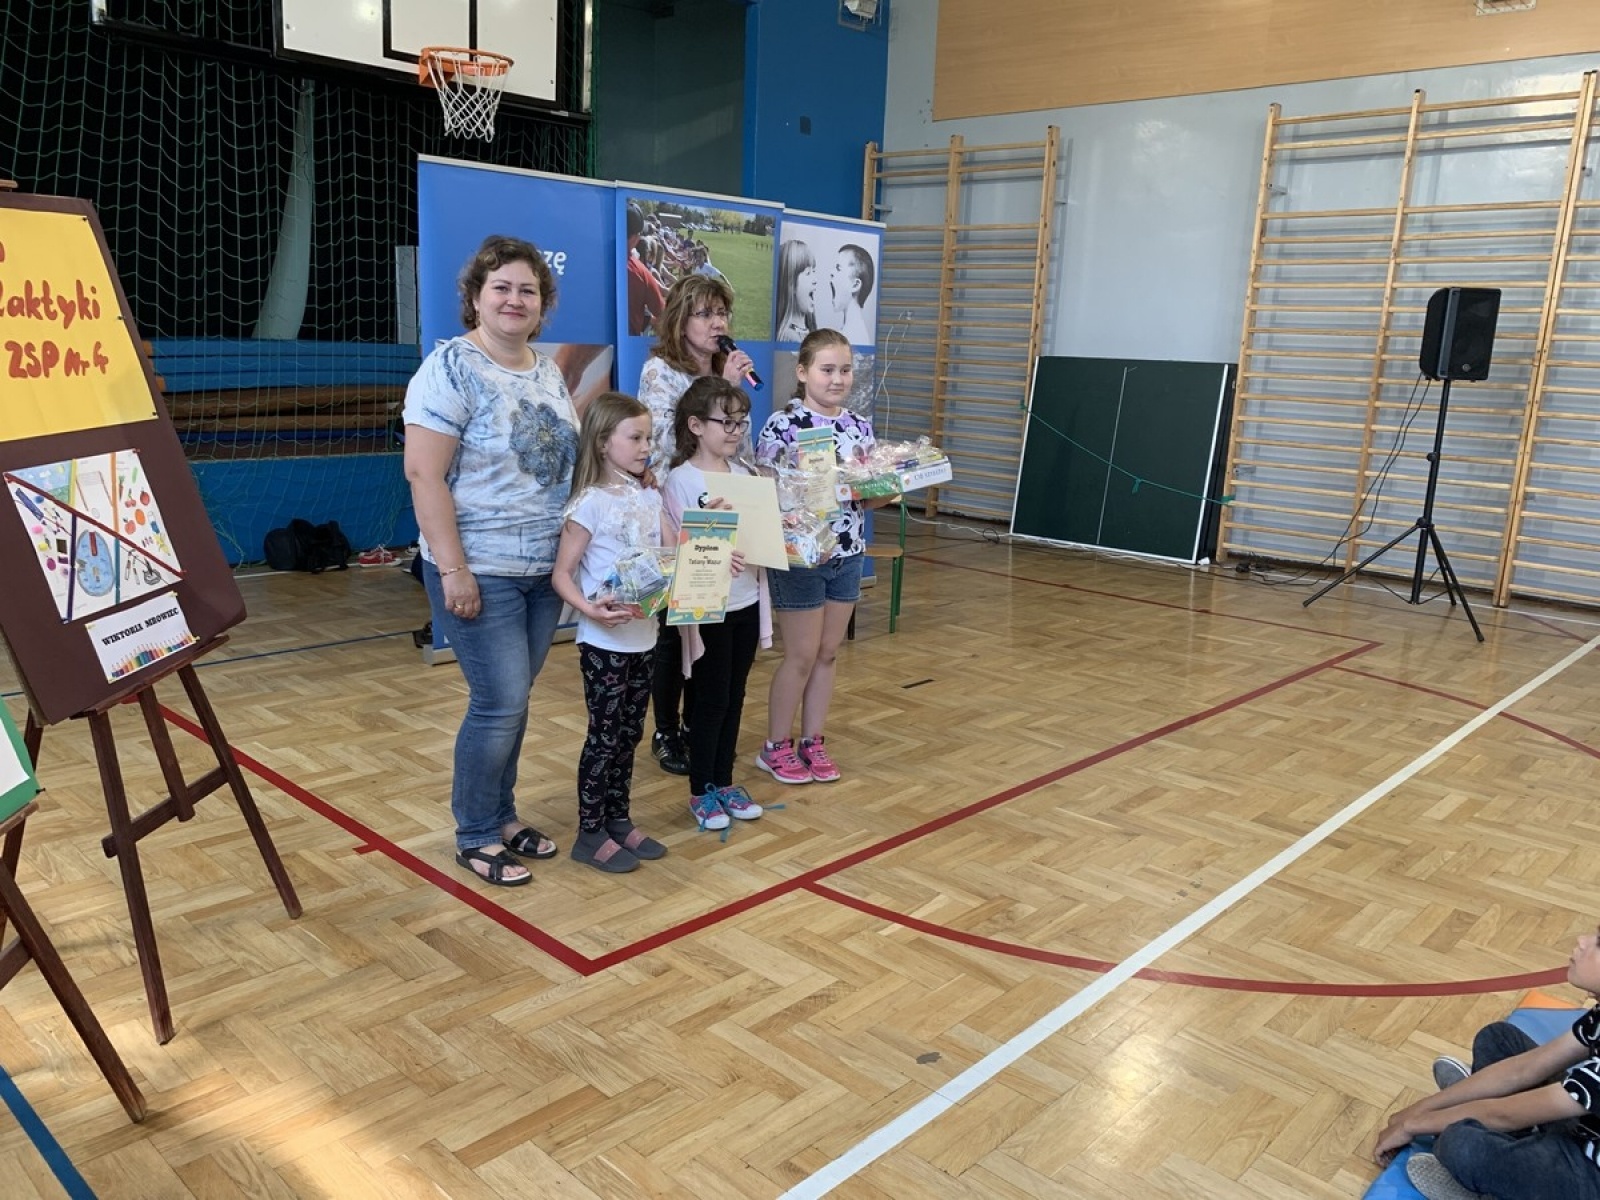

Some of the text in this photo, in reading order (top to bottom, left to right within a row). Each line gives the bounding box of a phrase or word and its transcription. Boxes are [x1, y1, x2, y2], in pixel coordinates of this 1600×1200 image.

[536, 249, 567, 276] zę
[4, 340, 60, 379] ZSP
[93, 341, 109, 375] 4
[101, 623, 144, 646] WIKTORIA
